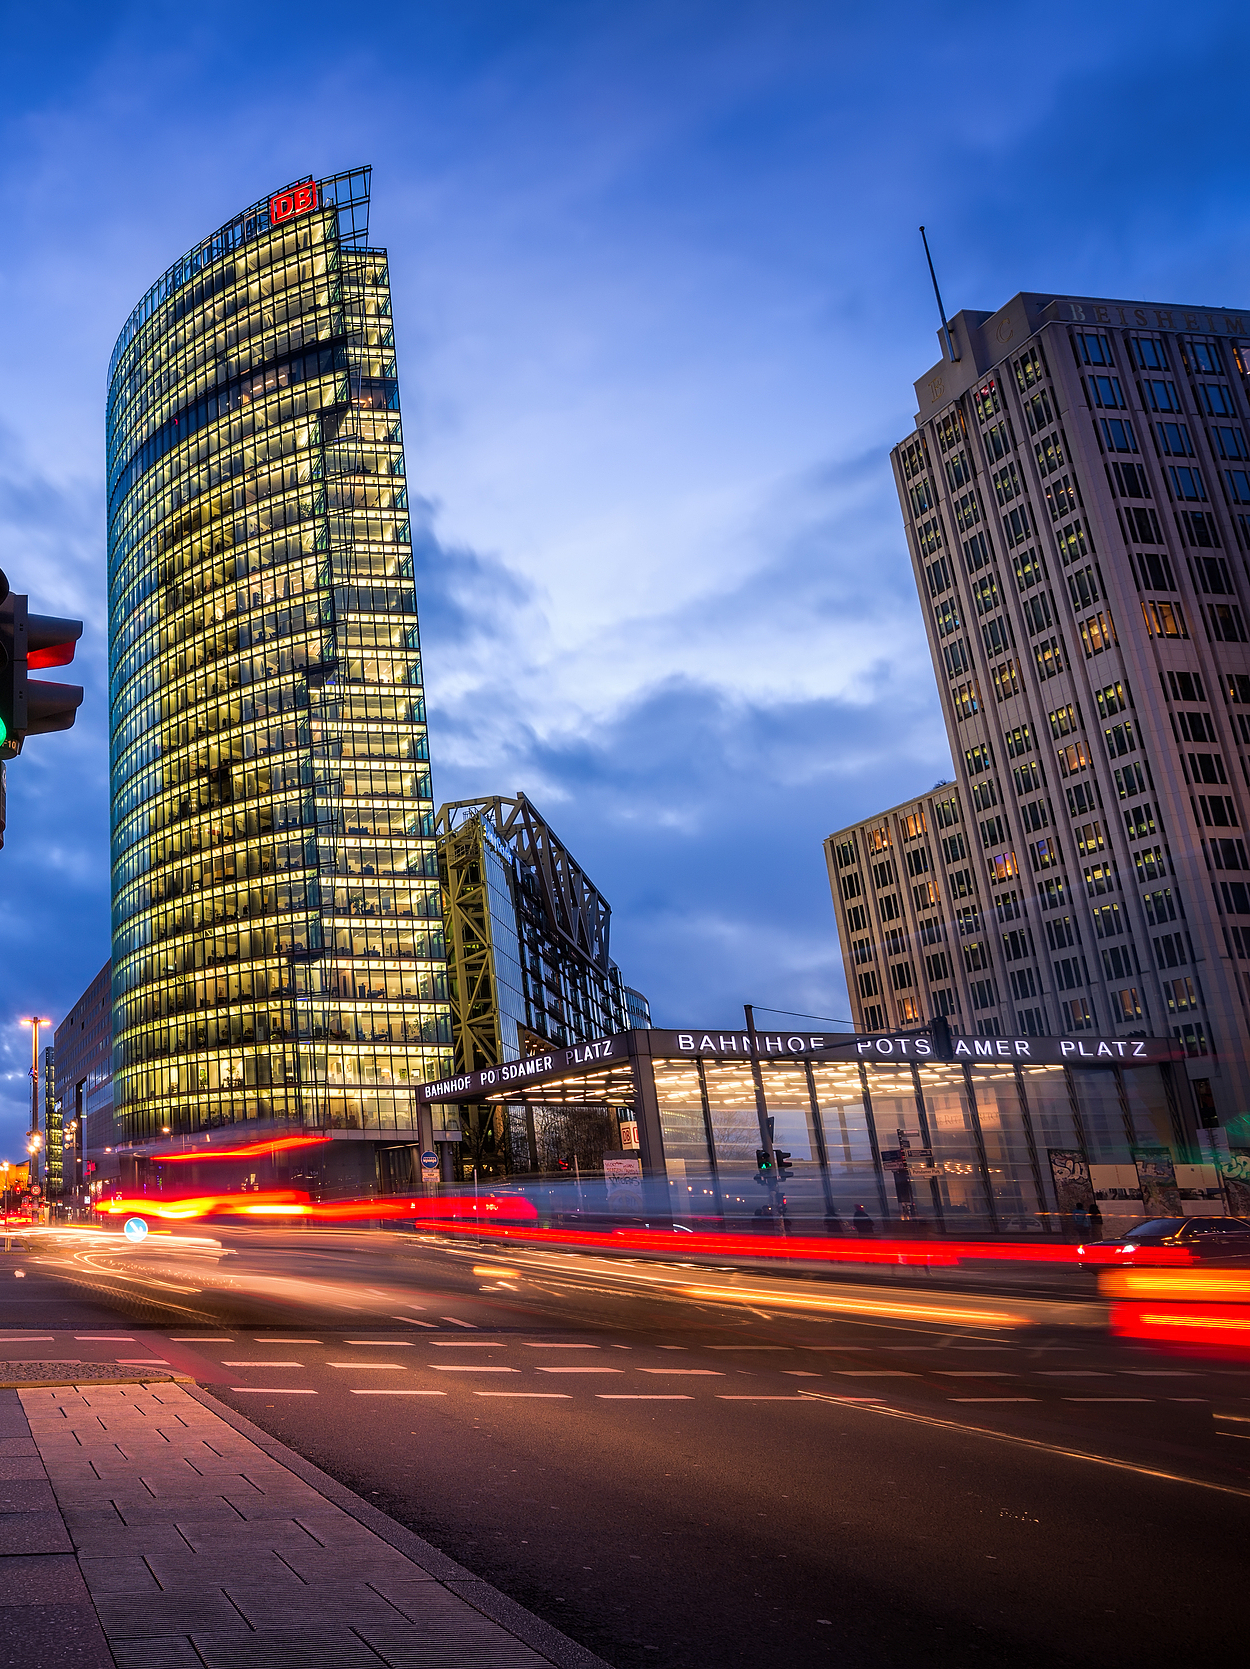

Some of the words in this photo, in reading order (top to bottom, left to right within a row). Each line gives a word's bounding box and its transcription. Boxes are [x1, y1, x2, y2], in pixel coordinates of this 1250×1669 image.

[274, 187, 312, 220] DB
[678, 1034, 824, 1053] BAHNHOF
[857, 1037, 1031, 1056] POTSAMER
[1060, 1040, 1147, 1057] PLATZ
[425, 1075, 472, 1098] BAHNHOF
[481, 1056, 553, 1085] POTSDAMER
[566, 1040, 613, 1065] PLATZ
